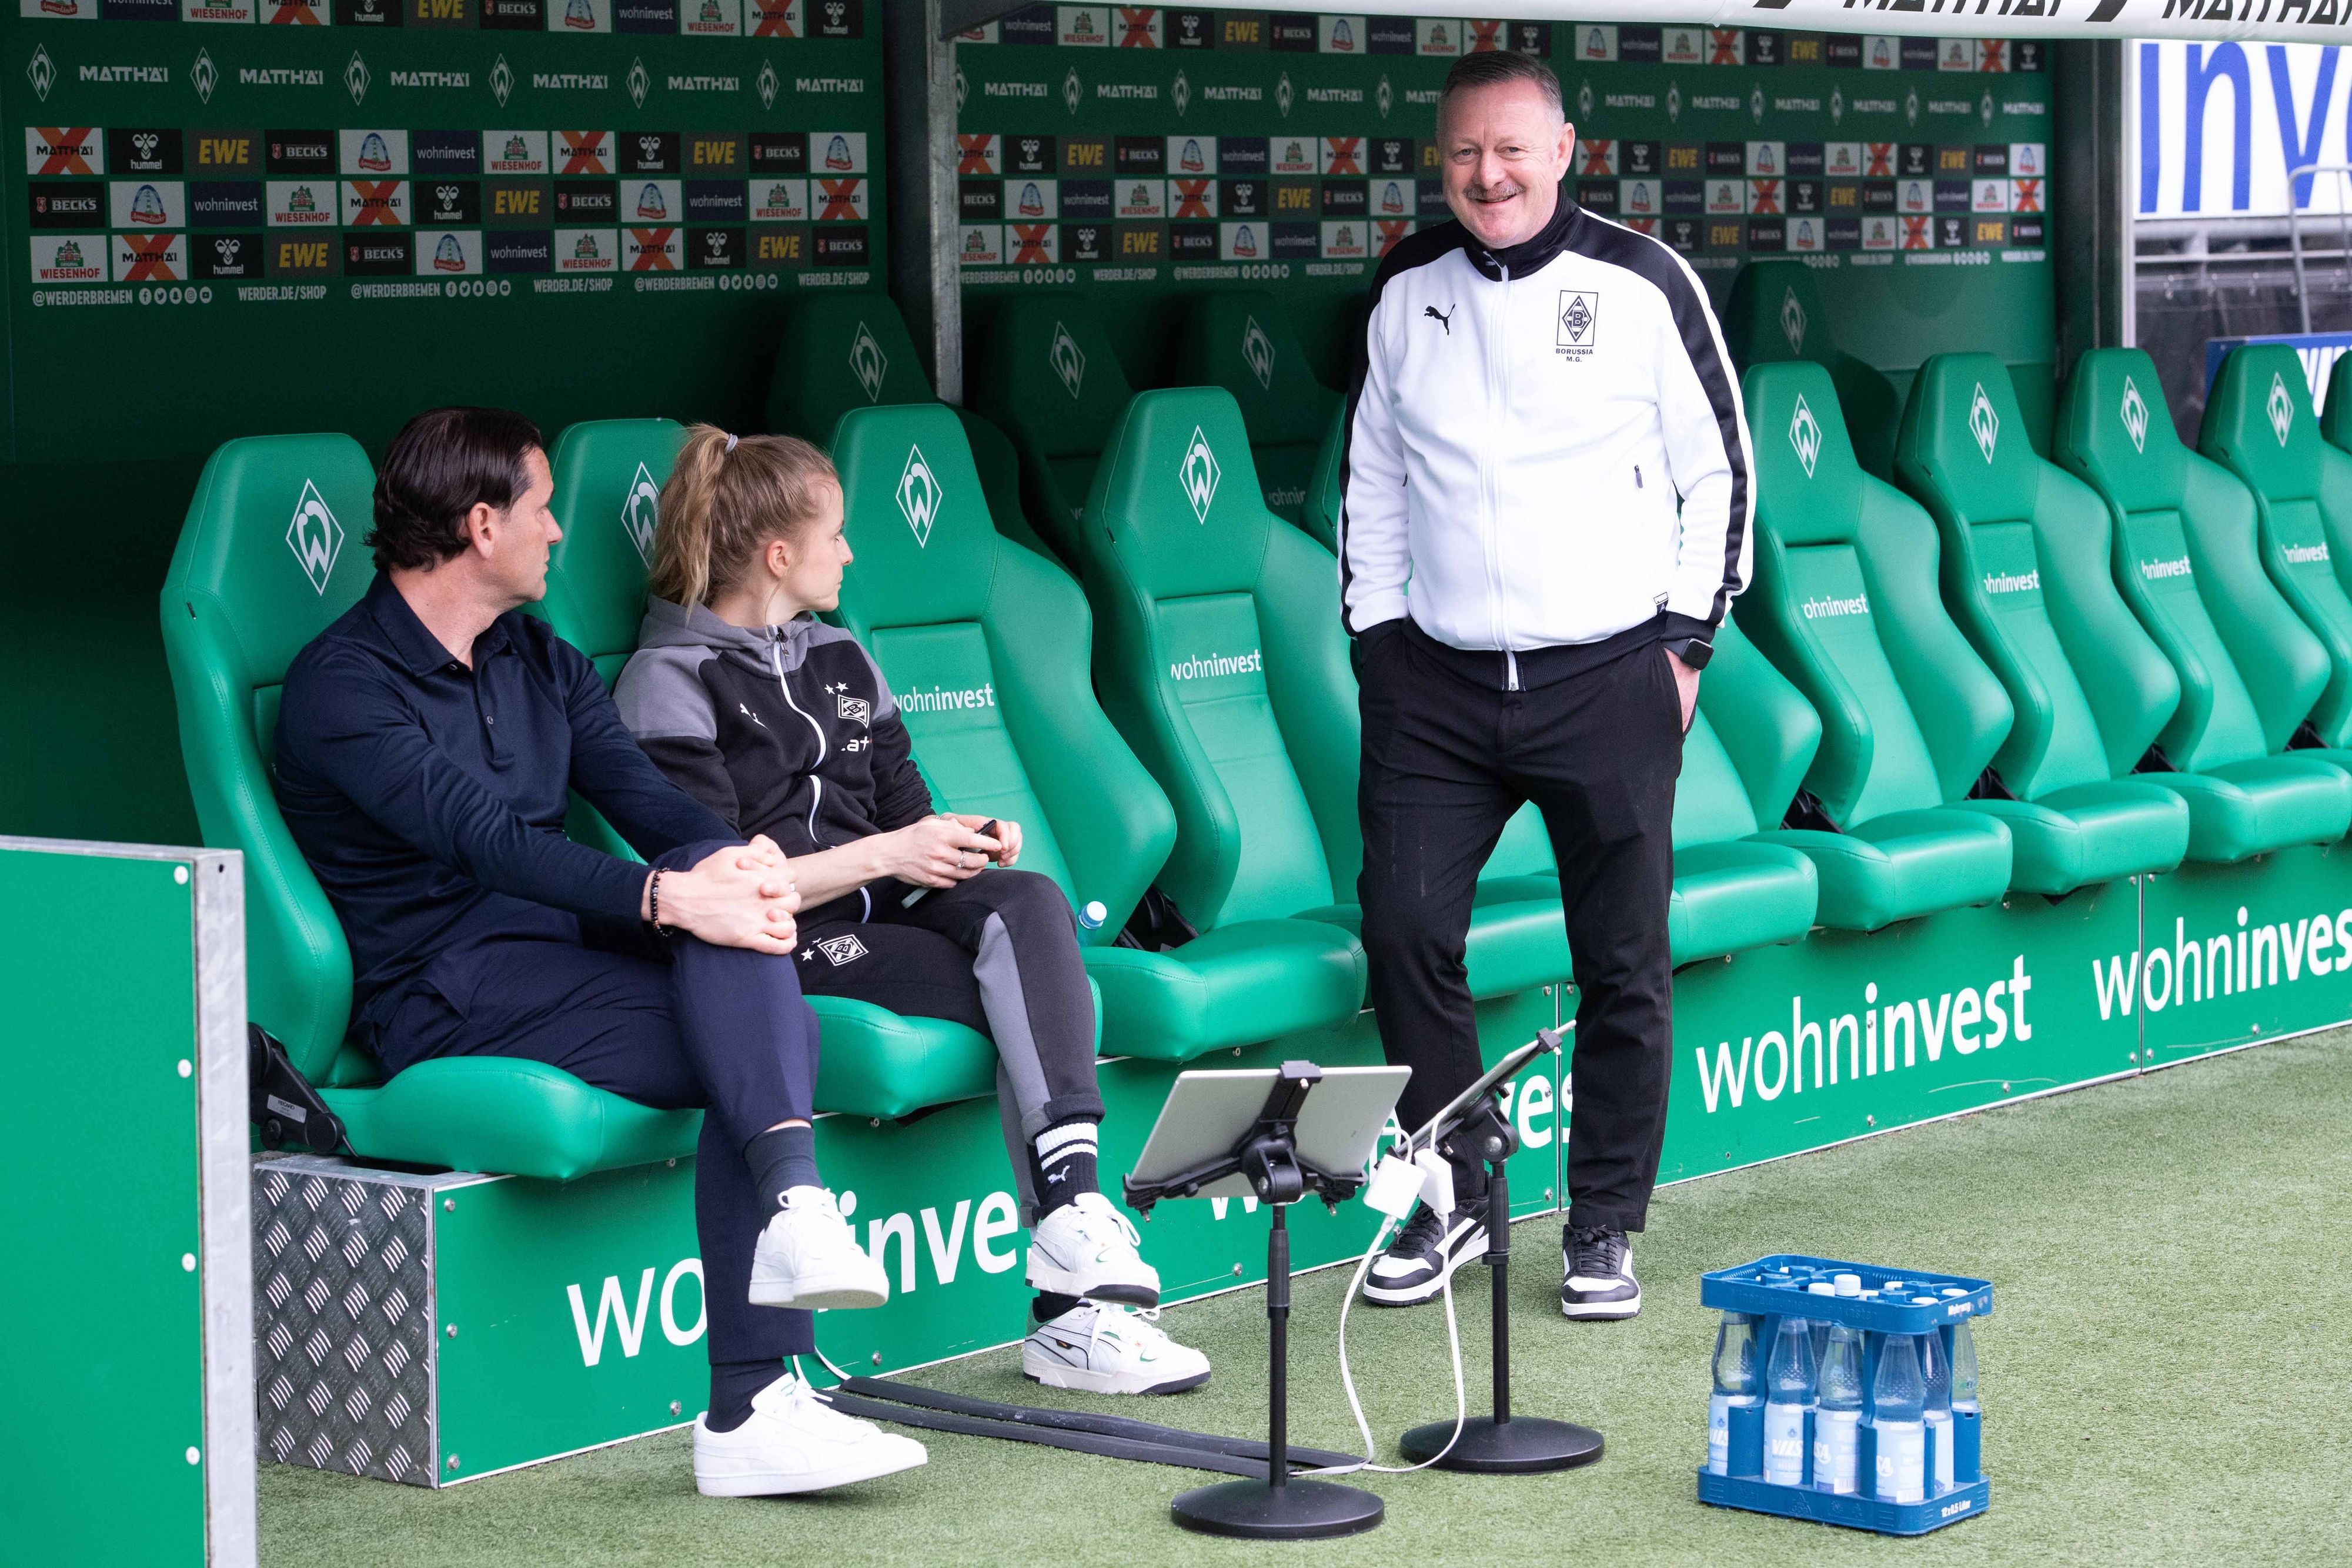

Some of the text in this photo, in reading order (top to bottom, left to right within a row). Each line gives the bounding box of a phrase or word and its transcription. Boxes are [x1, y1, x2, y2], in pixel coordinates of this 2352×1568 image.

[191, 8, 248, 19] WIESENHOF
[417, 0, 463, 19] EWE
[498, 4, 537, 15] BECK'S
[619, 7, 673, 20] wohninvest
[355, 12, 385, 22] hummel
[687, 22, 734, 32] WIESENHOF
[1225, 21, 1259, 42] EWE
[79, 66, 168, 82] MATTHÄI
[239, 69, 324, 85] MATTHÄI
[390, 71, 469, 88] MATTHÄI
[533, 73, 608, 89] MATTHÄI
[668, 76, 739, 91] MATTHÄI
[796, 78, 864, 92] MATTHÄI
[985, 82, 1048, 96] MATTHÄI
[1097, 85, 1157, 99] MATTHÄI
[1204, 87, 1262, 101] MATTHÄI
[2140, 40, 2352, 213] inv
[36, 146, 93, 155] MATTHÄI
[199, 139, 249, 165] EWE
[286, 146, 328, 158] BECK'S
[417, 146, 475, 159] wohninvest
[560, 148, 607, 157] MATTHÄI
[693, 141, 736, 165] EWE
[766, 147, 800, 158] BECK'S
[1067, 143, 1104, 166] EWE
[131, 159, 162, 170] hummel
[491, 161, 542, 170] WIESENHOF
[52, 199, 96, 212] BECK'S
[195, 198, 258, 212] wohninvest
[350, 198, 400, 207] MATTHÄI
[494, 190, 540, 214] EWE
[572, 195, 612, 207] BECK'S
[689, 195, 742, 208] wohninvest
[1278, 188, 1312, 209] EWE
[275, 212, 330, 222] WIESENHOF
[434, 210, 462, 220] hummel
[759, 236, 800, 259] EWE
[1122, 231, 1159, 253] EWE
[122, 253, 177, 262] MATTHÄI
[278, 243, 329, 268] EWE
[364, 248, 404, 259] BECK'S
[490, 246, 547, 259] wohninvest
[213, 264, 244, 275] hummel
[562, 259, 612, 269] WIESENHOF
[40, 268, 100, 279] WIESENHOF
[351, 282, 440, 299] @WERDERBREMEN
[533, 278, 613, 292] WERDER.DE/SHOP
[634, 276, 715, 292] @WERDERBREMEN
[32, 289, 133, 307] @WERDERBREMEN
[238, 285, 326, 301] WERDER.DE/SHOP
[1801, 593, 1869, 619] ohninvest
[1696, 954, 2032, 1114] wohninvest
